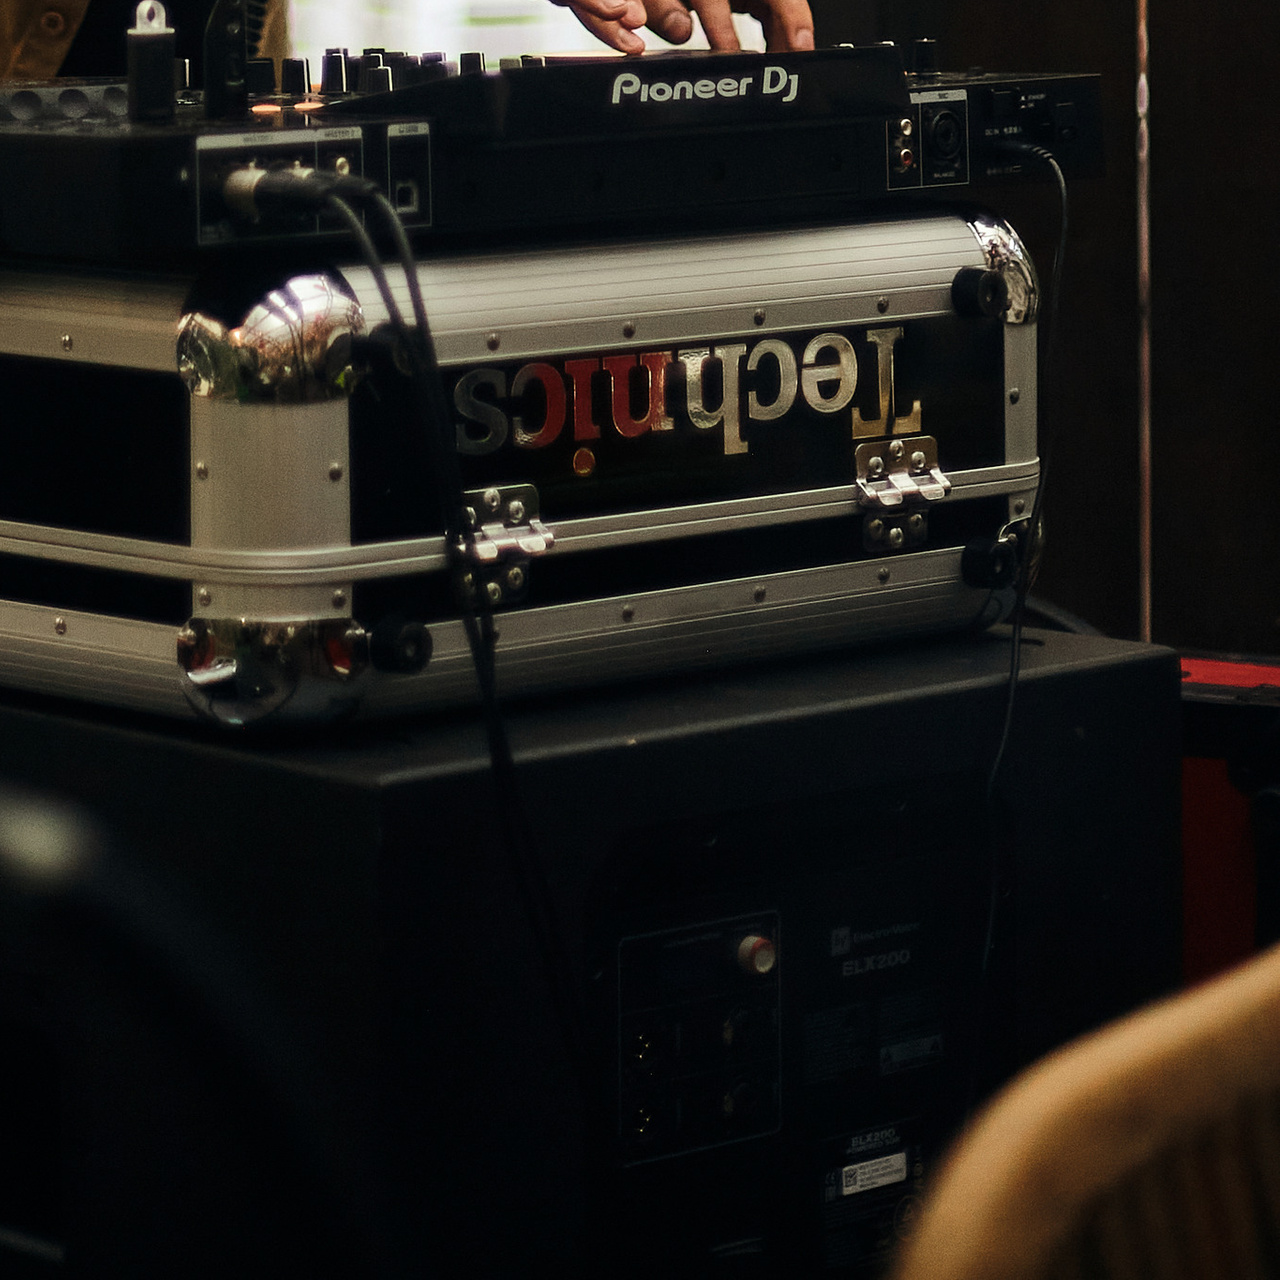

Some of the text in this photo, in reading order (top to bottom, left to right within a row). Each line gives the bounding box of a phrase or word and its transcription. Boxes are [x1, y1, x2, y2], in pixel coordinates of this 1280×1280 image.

[612, 72, 754, 104] Pioneer
[452, 326, 923, 477] Technics
[842, 949, 910, 976] ELX200
